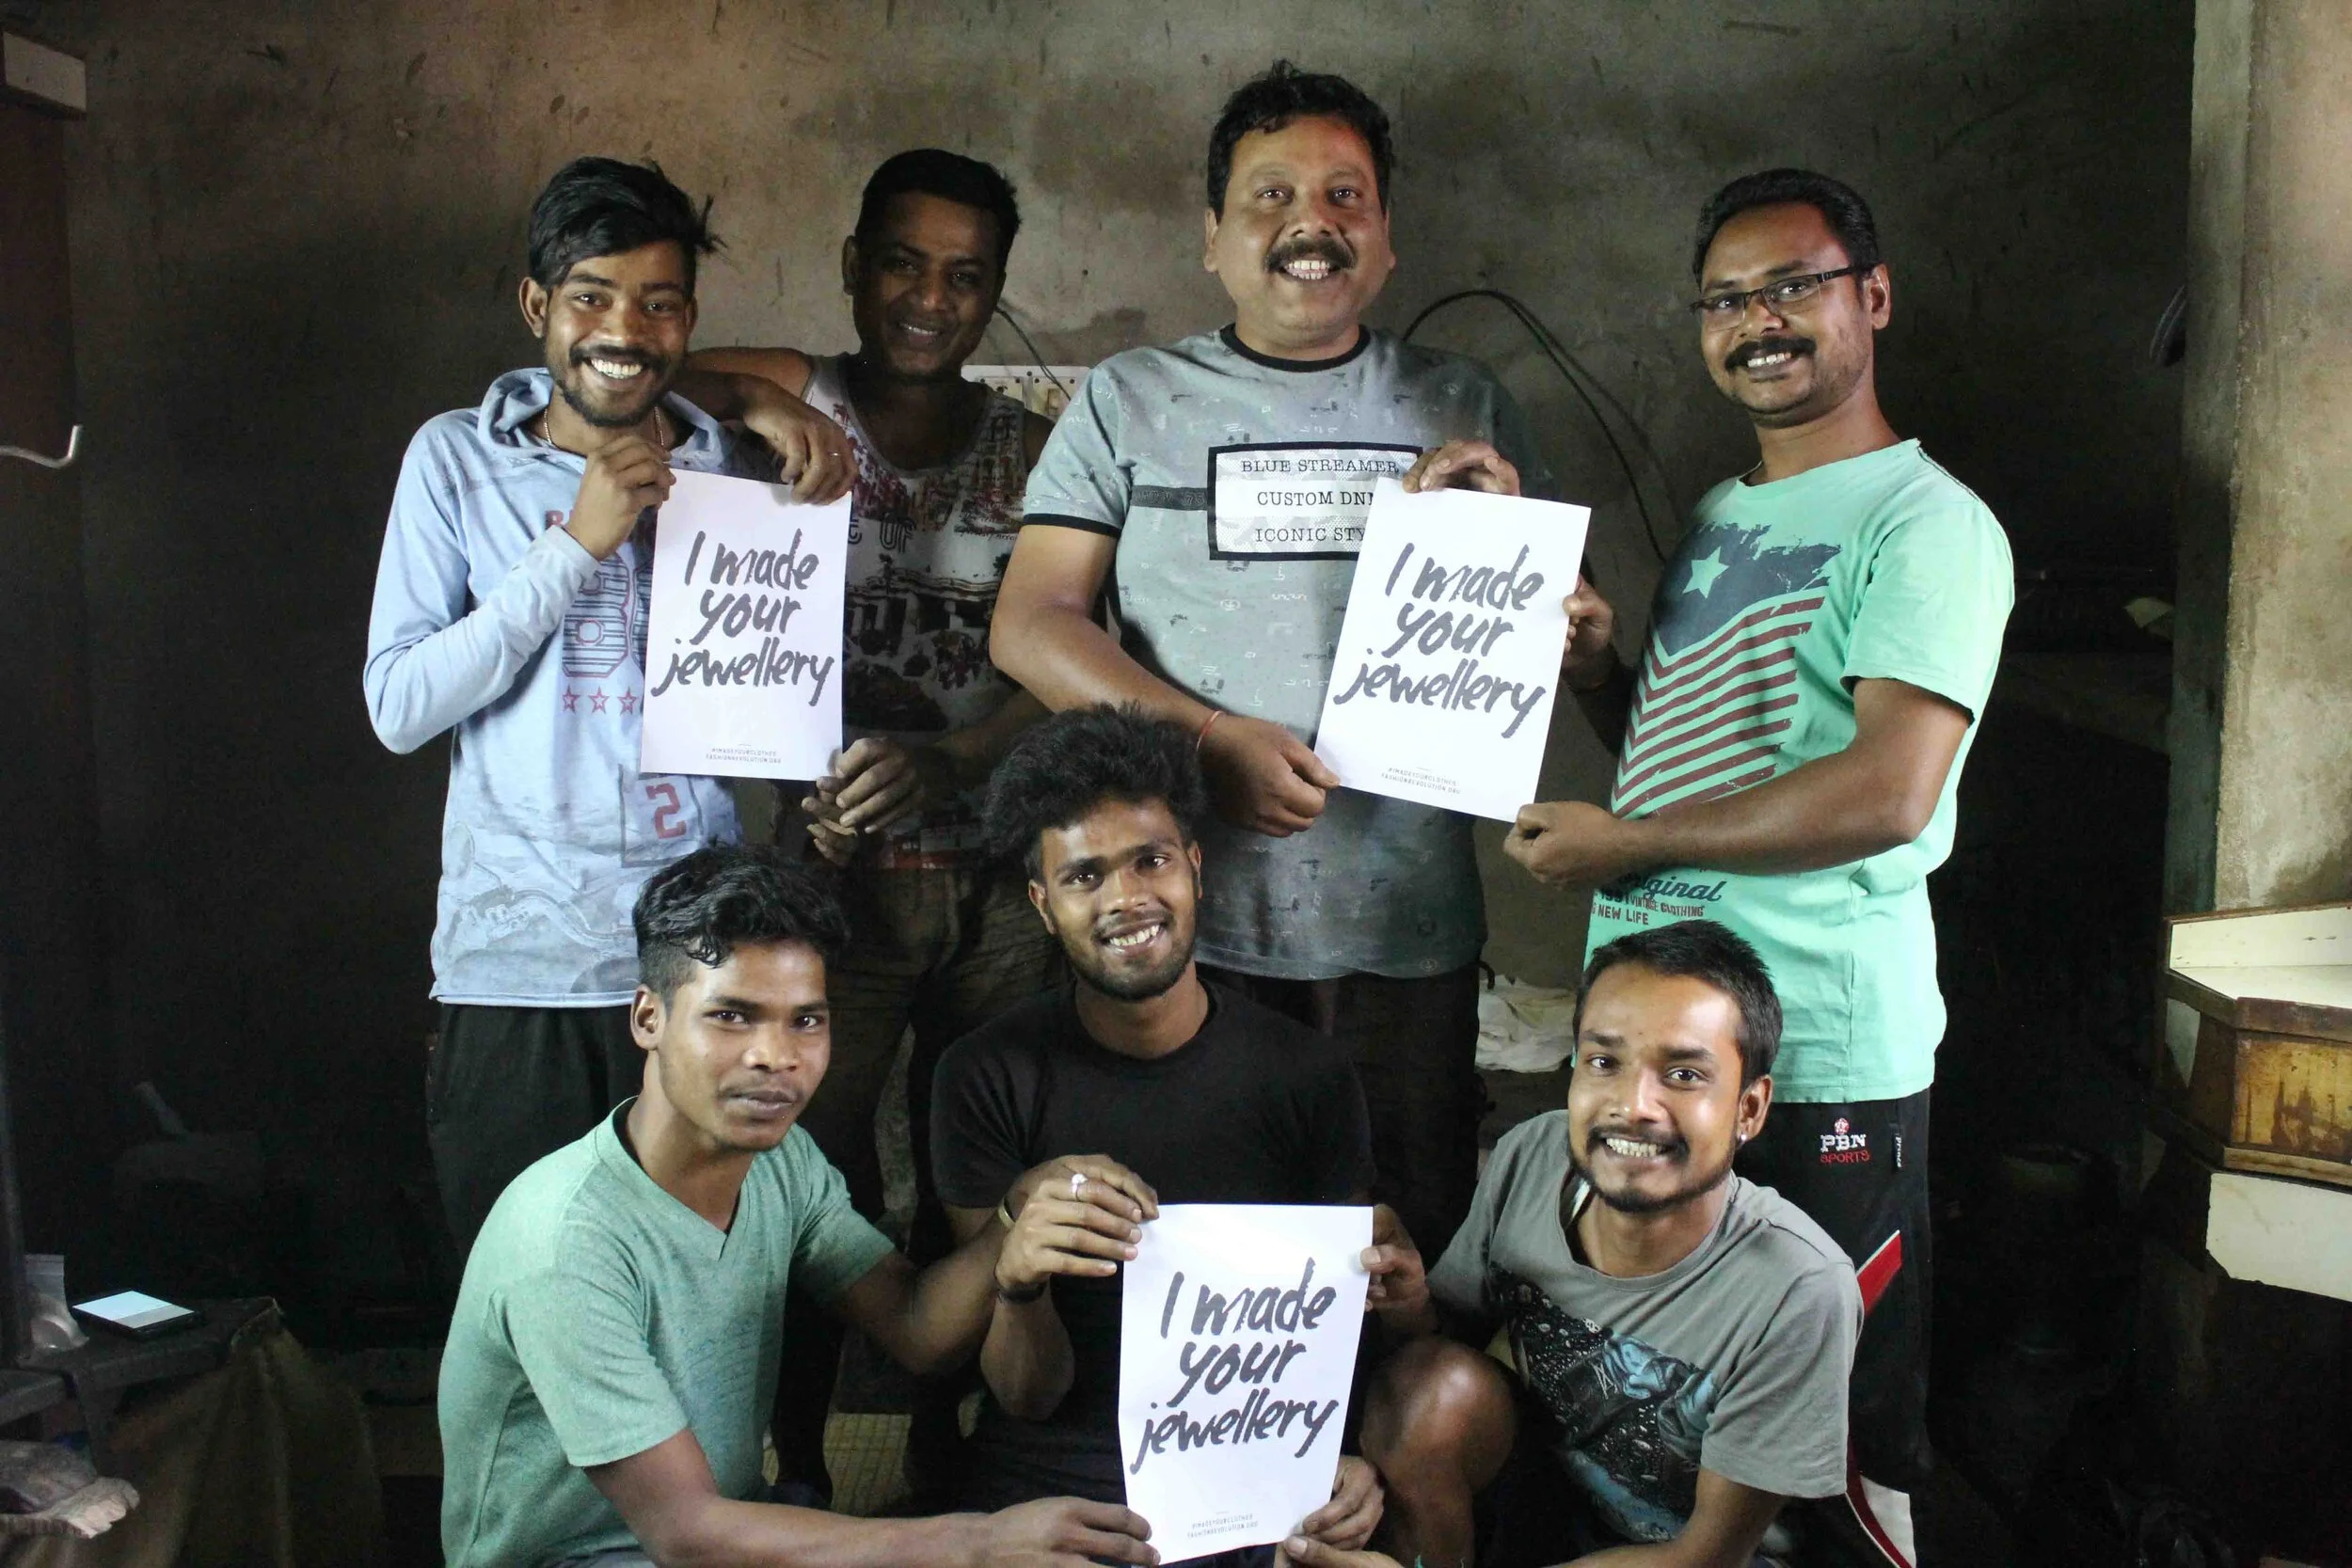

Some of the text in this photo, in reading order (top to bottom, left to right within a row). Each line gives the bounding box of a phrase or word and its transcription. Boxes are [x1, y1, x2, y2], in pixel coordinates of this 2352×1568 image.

[1241, 459, 1399, 473] BLUE STREAMER
[1257, 491, 1334, 506] CUSTOM
[685, 531, 706, 585] I
[710, 529, 818, 591] made
[1255, 527, 1366, 542] ICONIC STY
[1386, 543, 1544, 610] I made
[690, 590, 802, 645] your
[1381, 603, 1514, 658] your
[651, 637, 834, 706] jewellery
[1333, 648, 1546, 738] jewellery
[645, 783, 687, 839] 2
[1598, 904, 1622, 921] NEW
[1626, 910, 1649, 926] LIFE
[1660, 903, 1705, 918] CLOTHING
[1820, 1133, 1867, 1153] PBN
[1820, 1149, 1871, 1164] SPORTS
[1161, 1258, 1336, 1338] I made
[1167, 1339, 1307, 1407] your
[1130, 1387, 1339, 1475] jewellery
